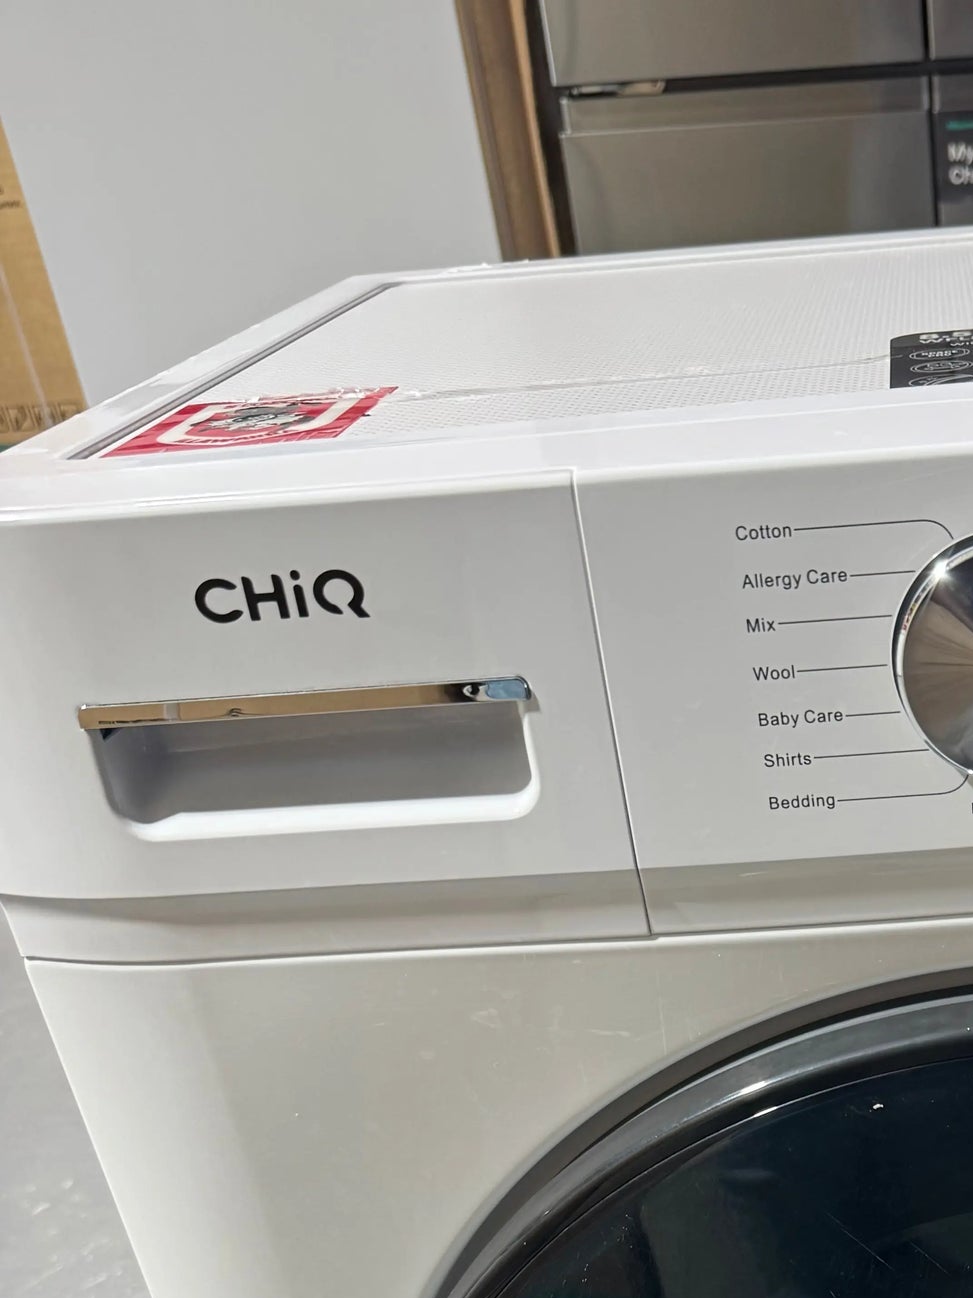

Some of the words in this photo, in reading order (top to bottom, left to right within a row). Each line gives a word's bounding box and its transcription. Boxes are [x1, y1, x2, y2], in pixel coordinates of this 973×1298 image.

[735, 523, 792, 541] Cotton
[742, 570, 802, 591] Allergy
[806, 568, 848, 586] Care
[195, 569, 371, 624] CHiQ
[745, 617, 776, 633] Mix
[753, 664, 796, 682] Wool
[757, 710, 799, 728] Baby
[802, 706, 844, 724] Care
[763, 750, 813, 768] Shirts
[768, 793, 836, 813] Bedding
